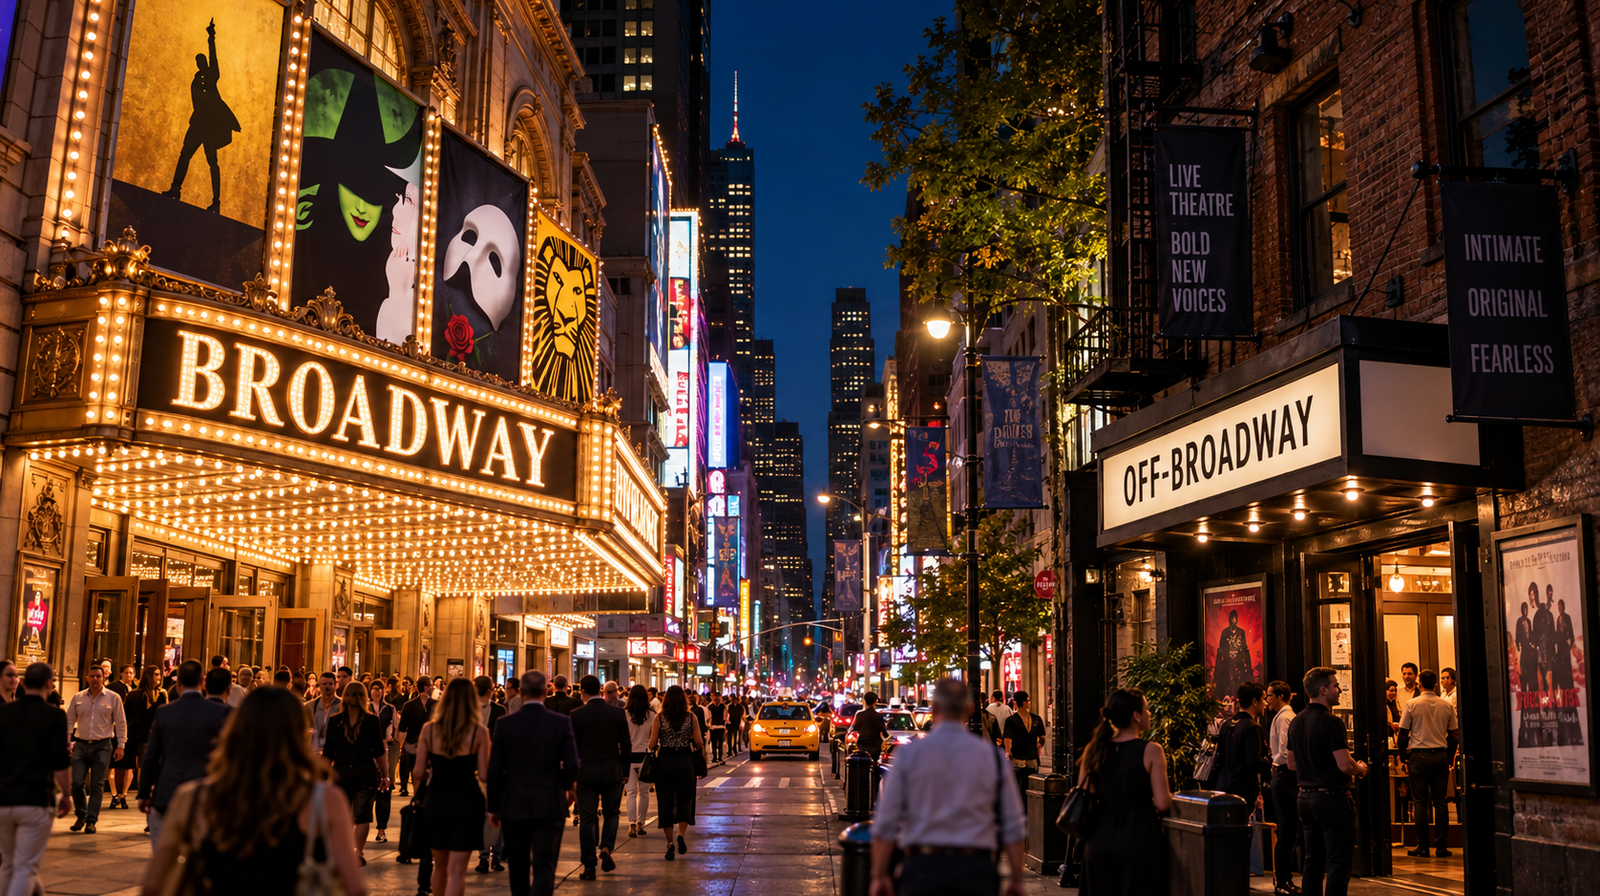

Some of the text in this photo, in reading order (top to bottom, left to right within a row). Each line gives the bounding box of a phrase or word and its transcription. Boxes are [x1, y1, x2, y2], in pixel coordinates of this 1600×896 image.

[1169, 164, 1201, 188] LIVE
[1169, 191, 1234, 217] THEATRE
[1171, 231, 1211, 255] BOLD
[1464, 234, 1543, 263] INTIMATE
[1172, 259, 1206, 283] NEW
[1172, 288, 1227, 313] VOICES
[1467, 287, 1548, 318] ORIGINAL
[1470, 343, 1554, 374] FEARLESS
[170, 329, 555, 488] BROADWAY
[1124, 394, 1313, 507] OFF-BROADWAY
